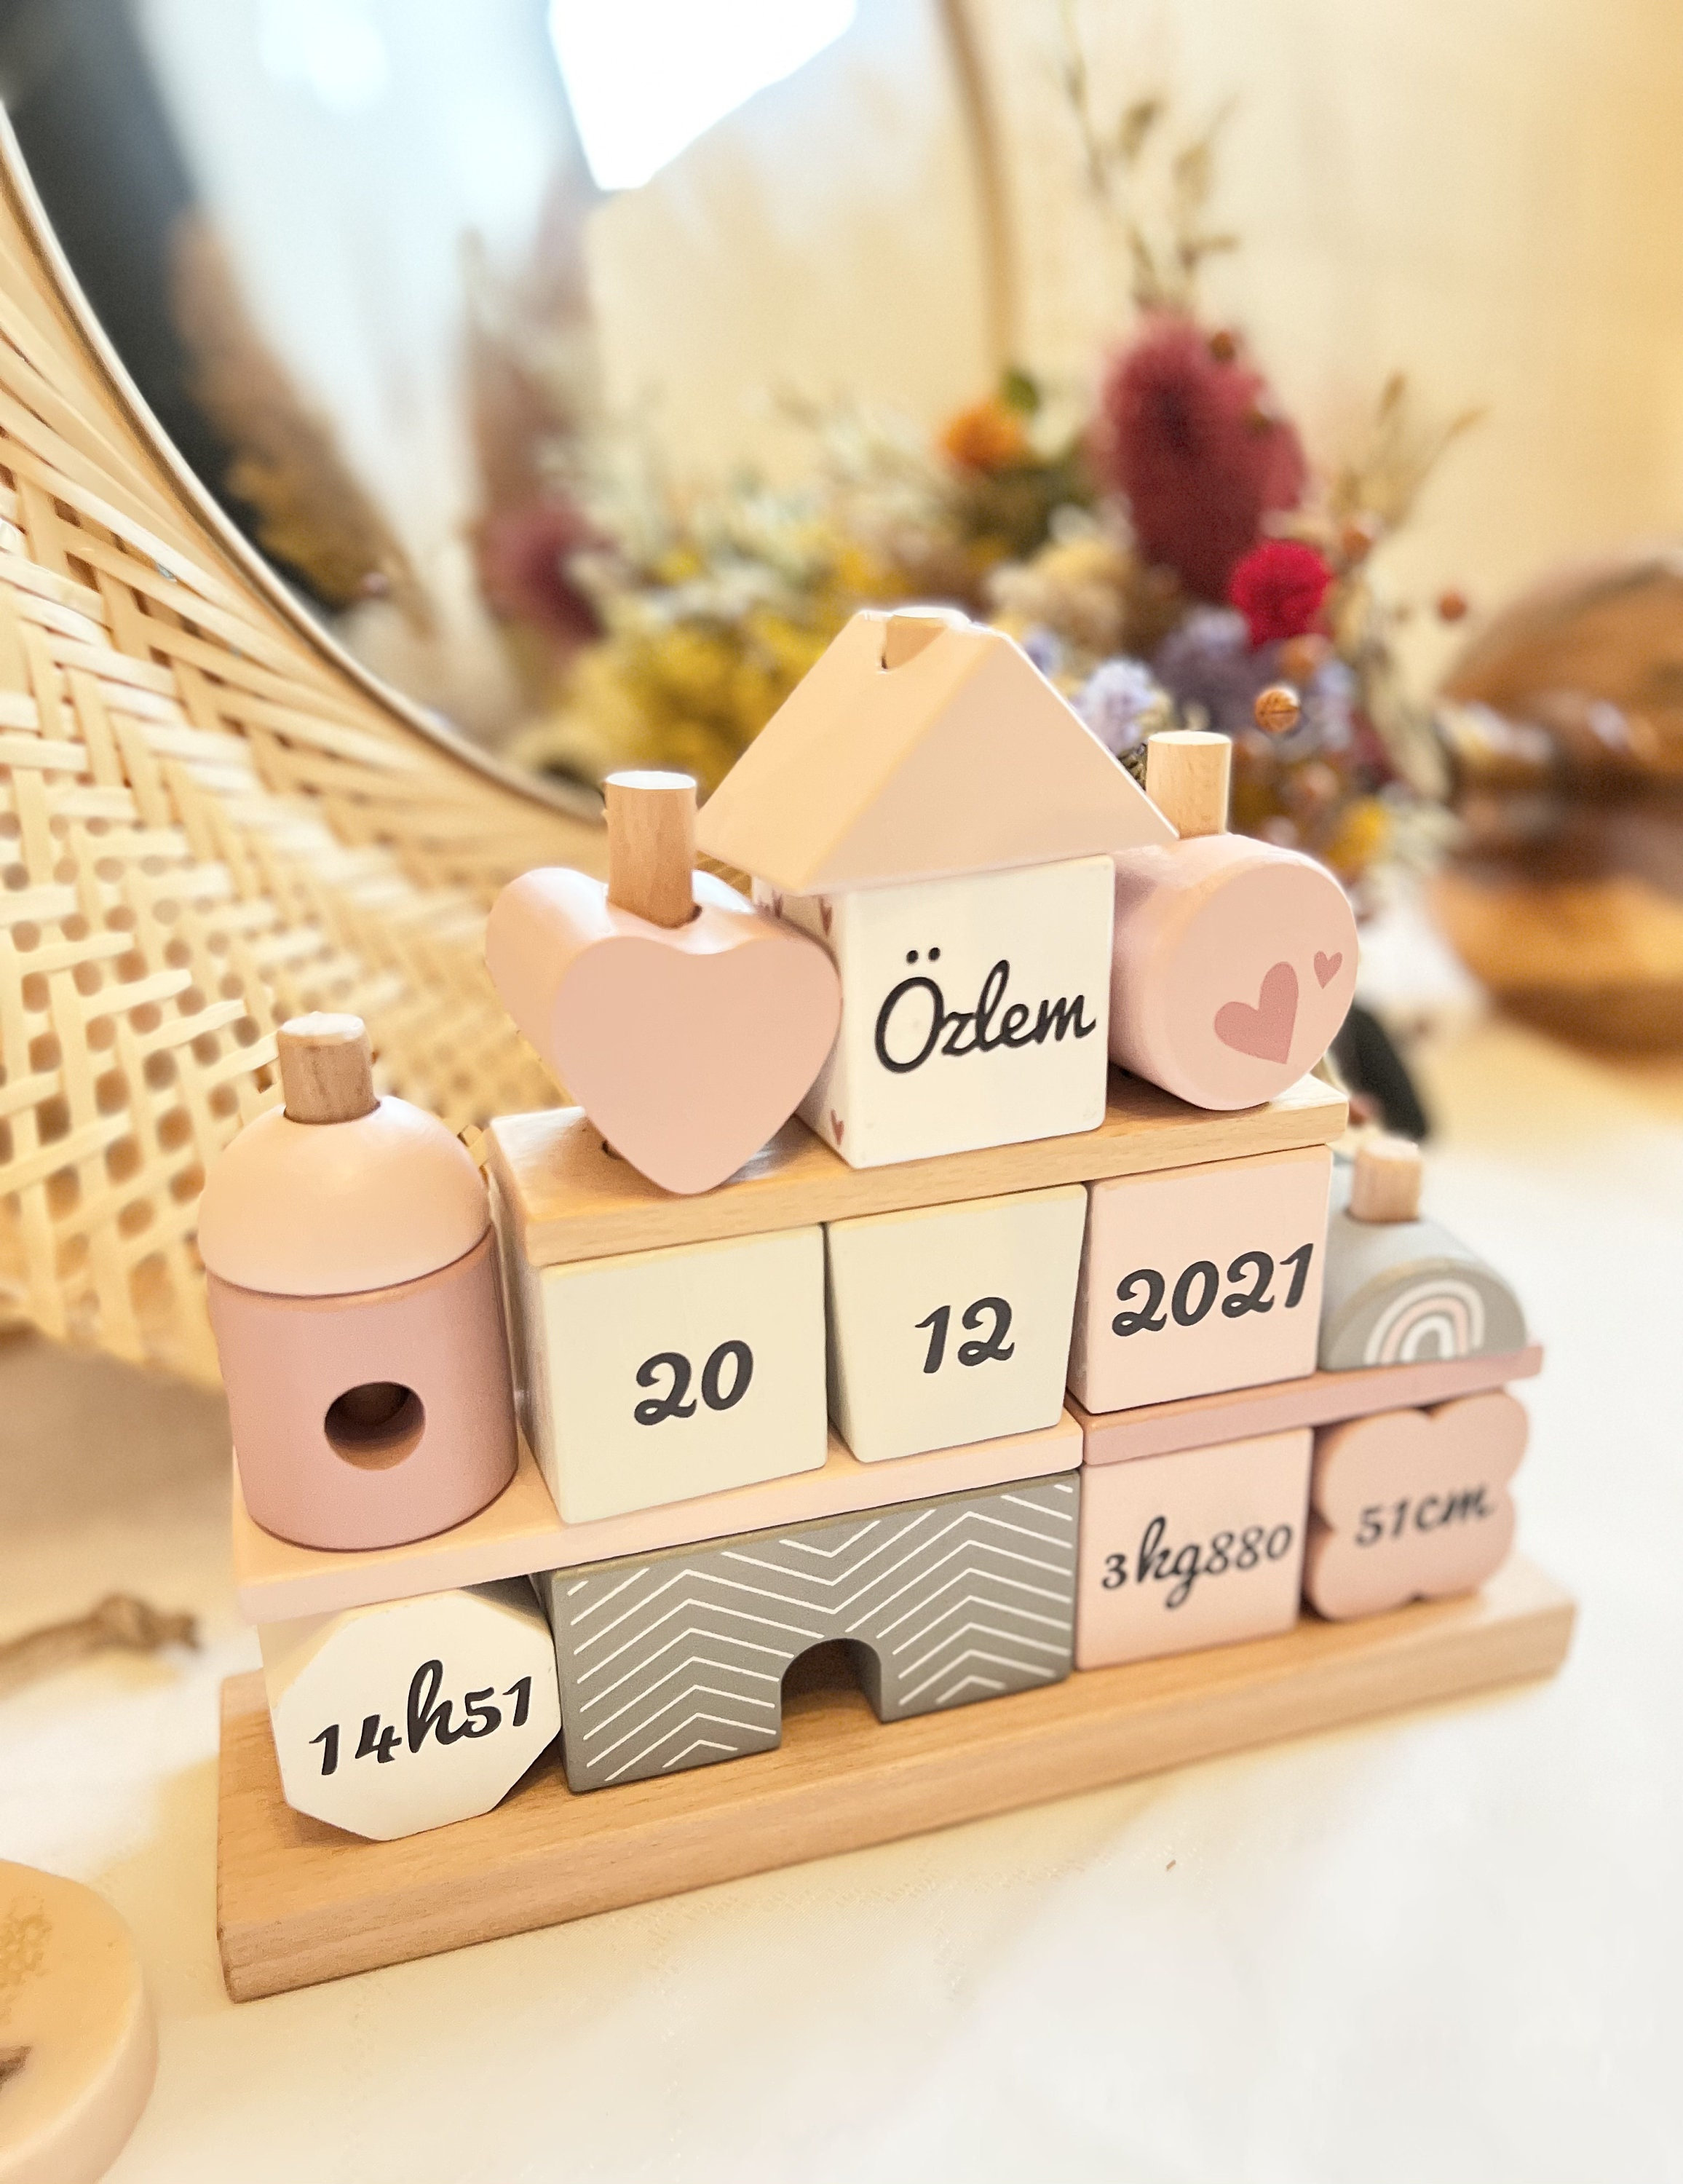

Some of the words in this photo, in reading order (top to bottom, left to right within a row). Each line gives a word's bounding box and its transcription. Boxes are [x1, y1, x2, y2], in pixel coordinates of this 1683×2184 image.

[875, 946, 1097, 1074] Özlem
[915, 1297, 1015, 1374] 12
[1112, 1243, 1314, 1337] 2021
[634, 1340, 754, 1426] 20
[1101, 1515, 1294, 1610] 3kg880
[1355, 1487, 1492, 1548] 51cm
[310, 1660, 532, 1776] 14h51
